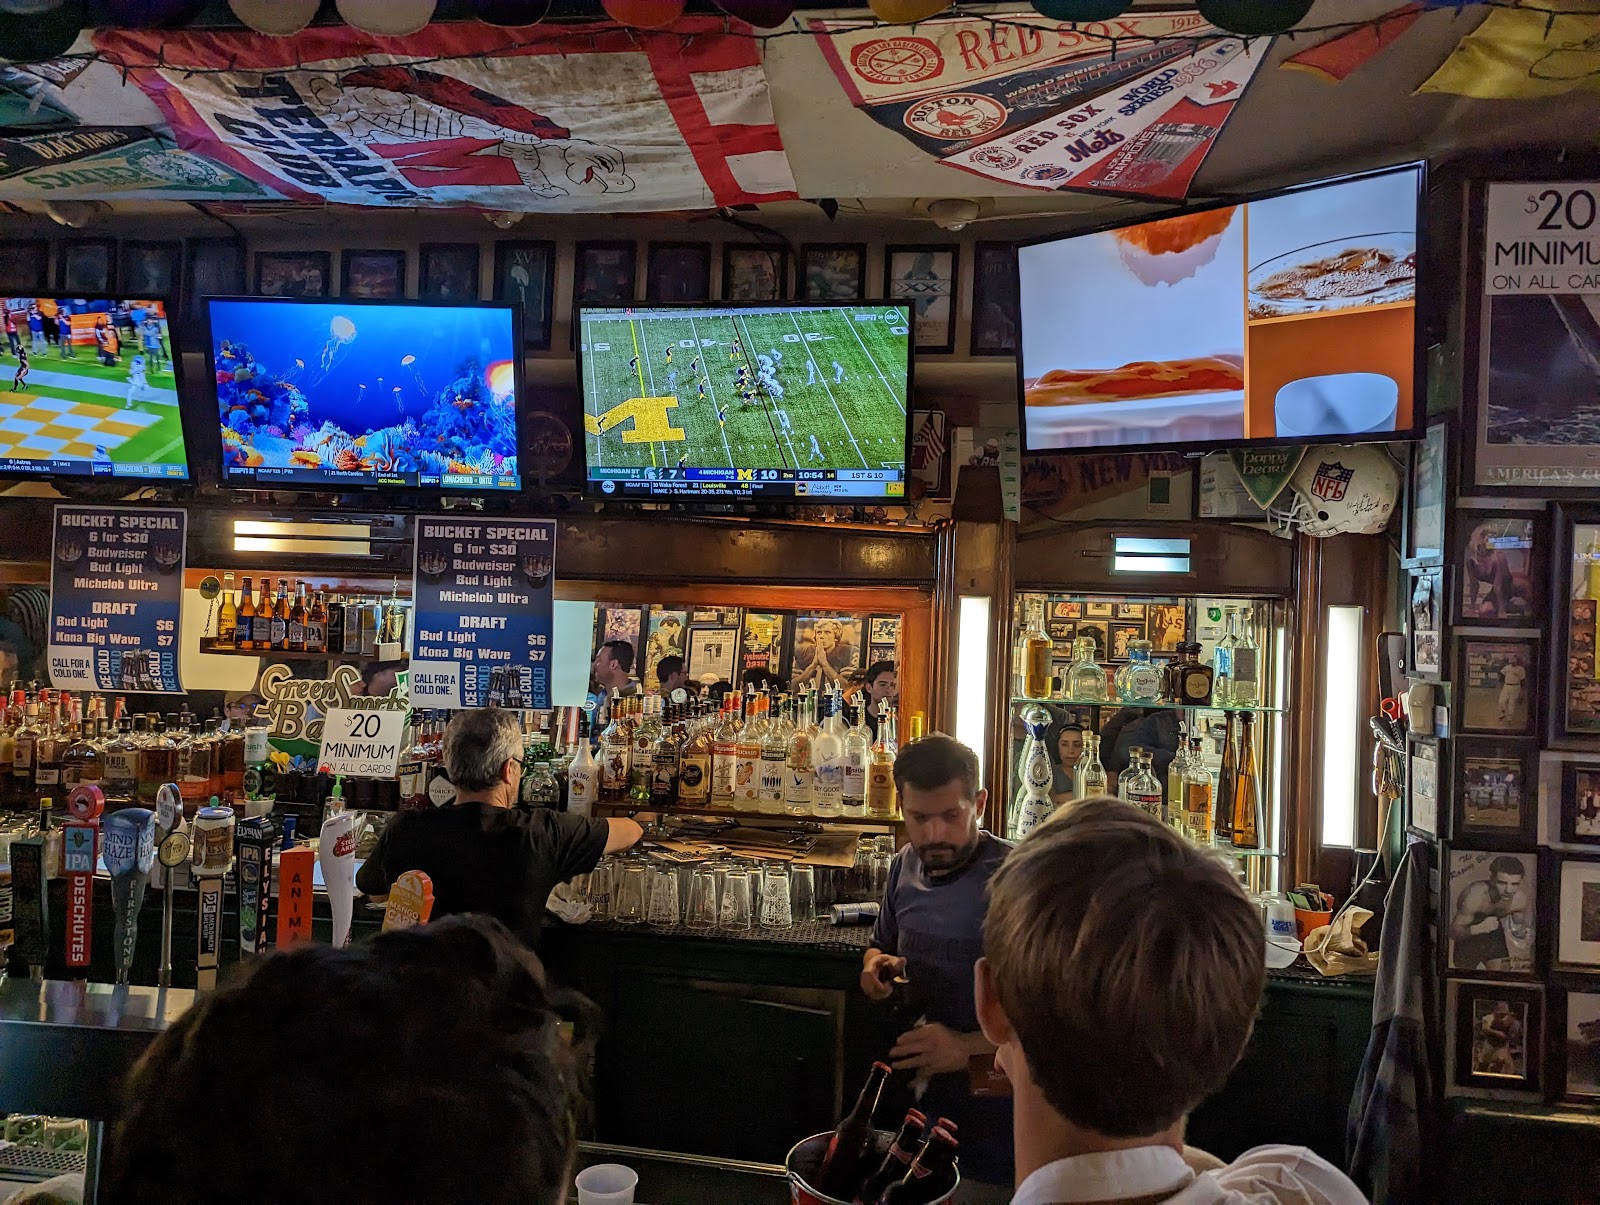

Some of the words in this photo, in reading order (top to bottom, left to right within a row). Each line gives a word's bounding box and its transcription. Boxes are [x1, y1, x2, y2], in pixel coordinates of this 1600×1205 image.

[954, 25, 1044, 72] RED
[1057, 21, 1143, 47] SOX
[1171, 16, 1201, 31] 1918
[1005, 79, 1055, 99] WORLD
[1055, 63, 1107, 81] SERIES
[1118, 68, 1179, 101] WORLD
[1171, 57, 1217, 88] 1986
[1118, 84, 1174, 116] SERIES
[912, 98, 979, 122] BOSTON
[939, 129, 971, 137] RED
[977, 115, 1000, 131] SOX
[1014, 131, 1059, 154] RED
[1056, 104, 1105, 130] SOX
[1079, 128, 1095, 139] NEW
[1096, 116, 1117, 129] YORK
[1064, 128, 1126, 163] Mets
[1104, 130, 1156, 181] CHAMPIONS
[1524, 189, 1596, 231] $20
[1492, 274, 1521, 290] ON
[1528, 274, 1560, 289] ALL
[669, 469, 678, 479] 7
[761, 470, 778, 479] 10
[798, 471, 824, 479] 10:54
[1314, 476, 1343, 500] NFL
[62, 515, 115, 528] BUCKET
[120, 516, 179, 530] SPECIAL
[89, 531, 98, 542] 6
[102, 532, 119, 542] for
[123, 532, 149, 544] $30
[424, 525, 482, 539] BUCKET
[486, 527, 549, 541] SPECIAL
[87, 547, 148, 559] Budweiser
[453, 543, 463, 554] 6
[467, 544, 485, 555] for
[489, 544, 517, 556] $30
[90, 562, 112, 573] Bud
[115, 563, 143, 575] Light
[453, 559, 517, 572] Budweiser
[74, 577, 124, 590] Michelob
[128, 579, 158, 591] Ultra
[456, 575, 479, 586] Bud
[483, 575, 513, 589] Light
[439, 591, 493, 604] Michelob
[497, 593, 529, 605] Ultra
[92, 602, 138, 615] DRAFT
[56, 616, 77, 627] Bud
[81, 616, 109, 629] Light
[156, 619, 174, 631] $6
[459, 615, 507, 630] DRAFT
[56, 631, 83, 643] Kona
[87, 632, 106, 645] Big
[109, 633, 141, 645] Wave
[158, 635, 174, 647] $7
[419, 630, 443, 642] Bud
[447, 631, 476, 644] Light
[527, 634, 547, 646] $6
[98, 649, 109, 672] COLD
[419, 646, 449, 658] Kona
[453, 647, 473, 661] Big
[478, 648, 511, 660] Wave
[529, 649, 546, 662] $7
[52, 658, 70, 668] CALL
[71, 659, 84, 668] FOR
[85, 659, 91, 669] A
[148, 651, 160, 676] COLD
[162, 652, 173, 676] COLD
[53, 668, 72, 678] COLD
[72, 669, 89, 679] ONE.
[99, 673, 114, 689] ICE
[414, 674, 433, 684] CALL
[434, 674, 449, 684] FOR
[450, 675, 456, 685] A
[465, 664, 477, 690] COLD
[478, 665, 491, 691] COLD
[520, 666, 532, 692] COLD
[534, 667, 546, 693] COLD
[163, 677, 178, 691] ICE
[261, 664, 336, 704] Green
[414, 685, 434, 695] COLD
[434, 686, 453, 696] ONE.
[466, 691, 477, 706] ICE
[534, 694, 546, 708] ICE
[256, 700, 323, 740] Ba
[344, 713, 381, 738] $20
[324, 742, 395, 760] MINIMUM
[105, 756, 126, 766] KNOB
[340, 762, 356, 773] ALL
[359, 763, 392, 774] CARDS
[106, 832, 133, 846] MIND
[237, 825, 263, 840] ELYSIAN
[105, 845, 132, 858] HAZE
[242, 847, 260, 861] IPA
[66, 854, 90, 869] IPA
[389, 901, 419, 919] MANGO
[72, 876, 86, 962] DESCHUTES
